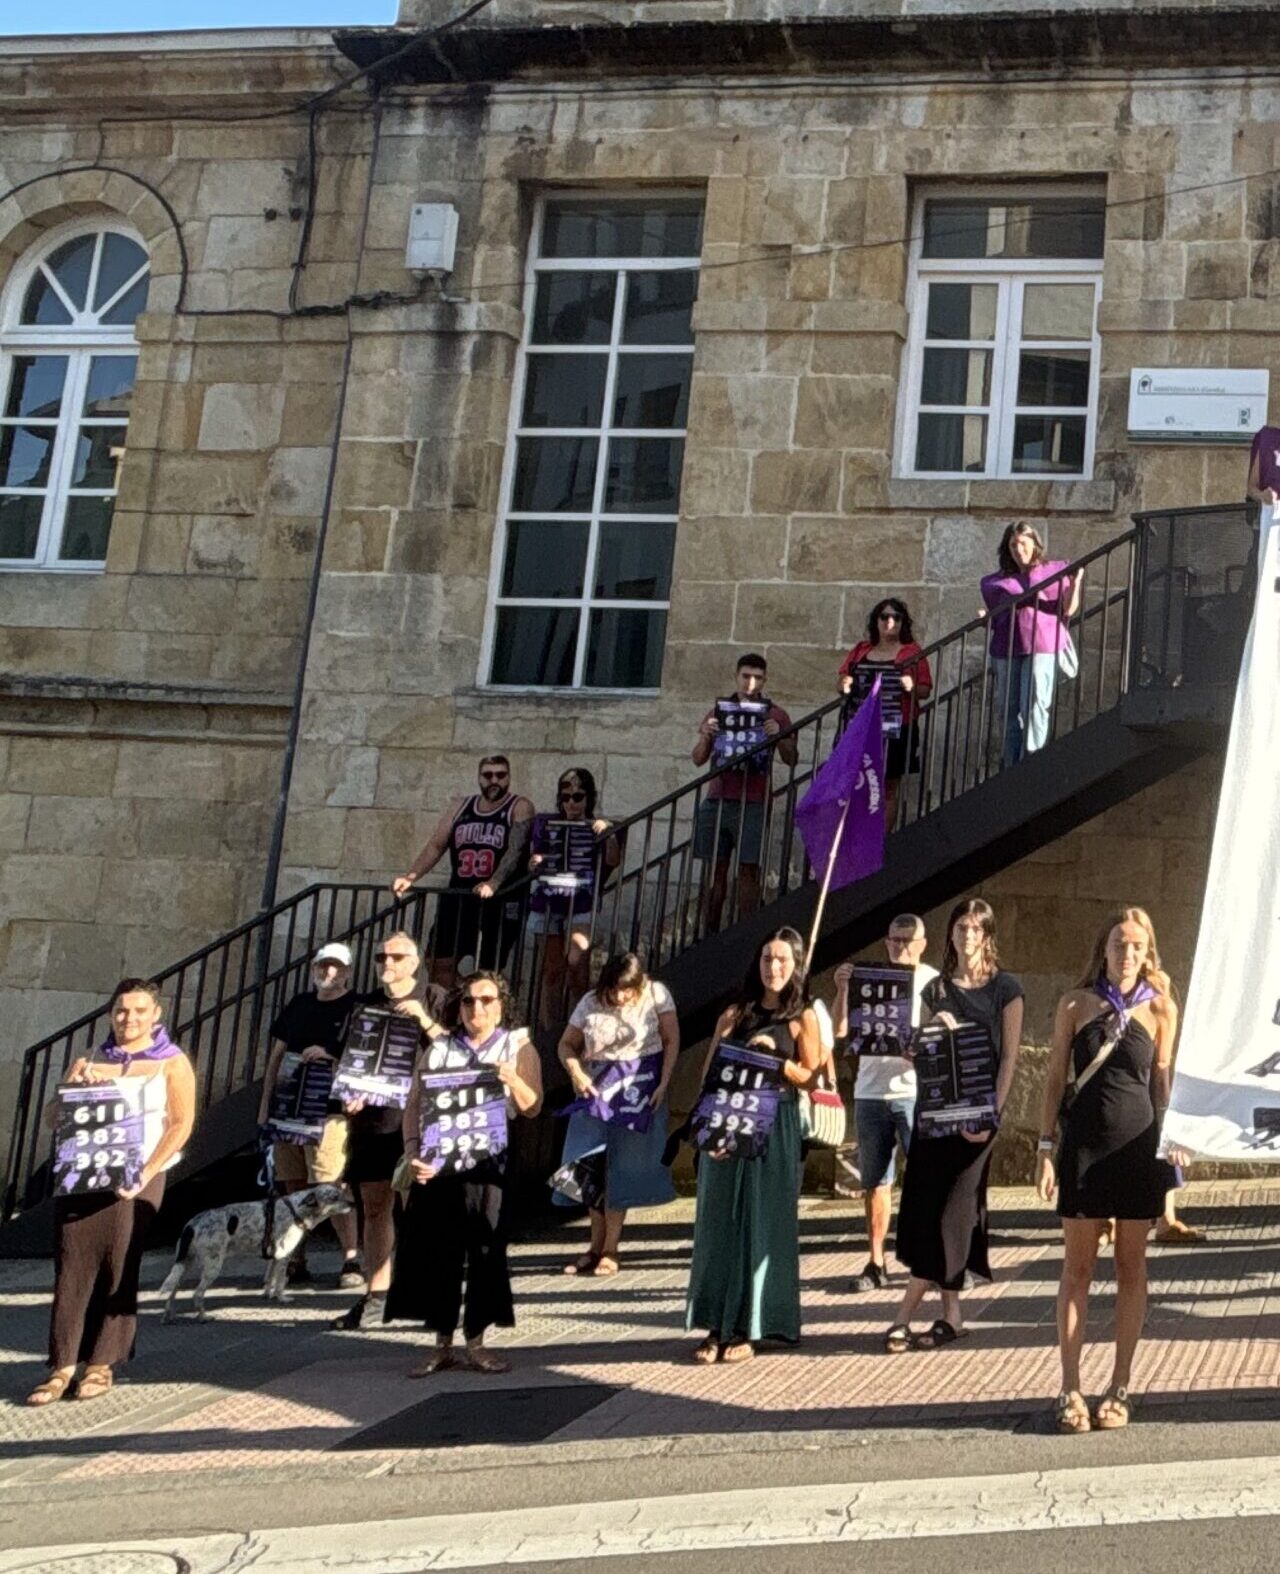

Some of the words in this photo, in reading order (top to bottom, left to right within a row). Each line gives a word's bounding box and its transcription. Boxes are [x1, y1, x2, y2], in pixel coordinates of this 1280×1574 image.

[725, 714, 757, 727] 611
[725, 730, 758, 742] 382
[455, 822, 505, 849] BULLS
[457, 849, 496, 878] 33
[861, 983, 898, 999] 611
[861, 1002, 899, 1018] 382
[861, 1021, 898, 1037] 392
[720, 1065, 764, 1090] 611
[435, 1087, 485, 1110] 611
[714, 1087, 760, 1113] 382
[73, 1103, 125, 1125] 611
[438, 1111, 488, 1132] 382
[709, 1111, 755, 1136] 392
[75, 1126, 127, 1147] 382
[439, 1132, 489, 1155] 392
[75, 1149, 126, 1171] 392
